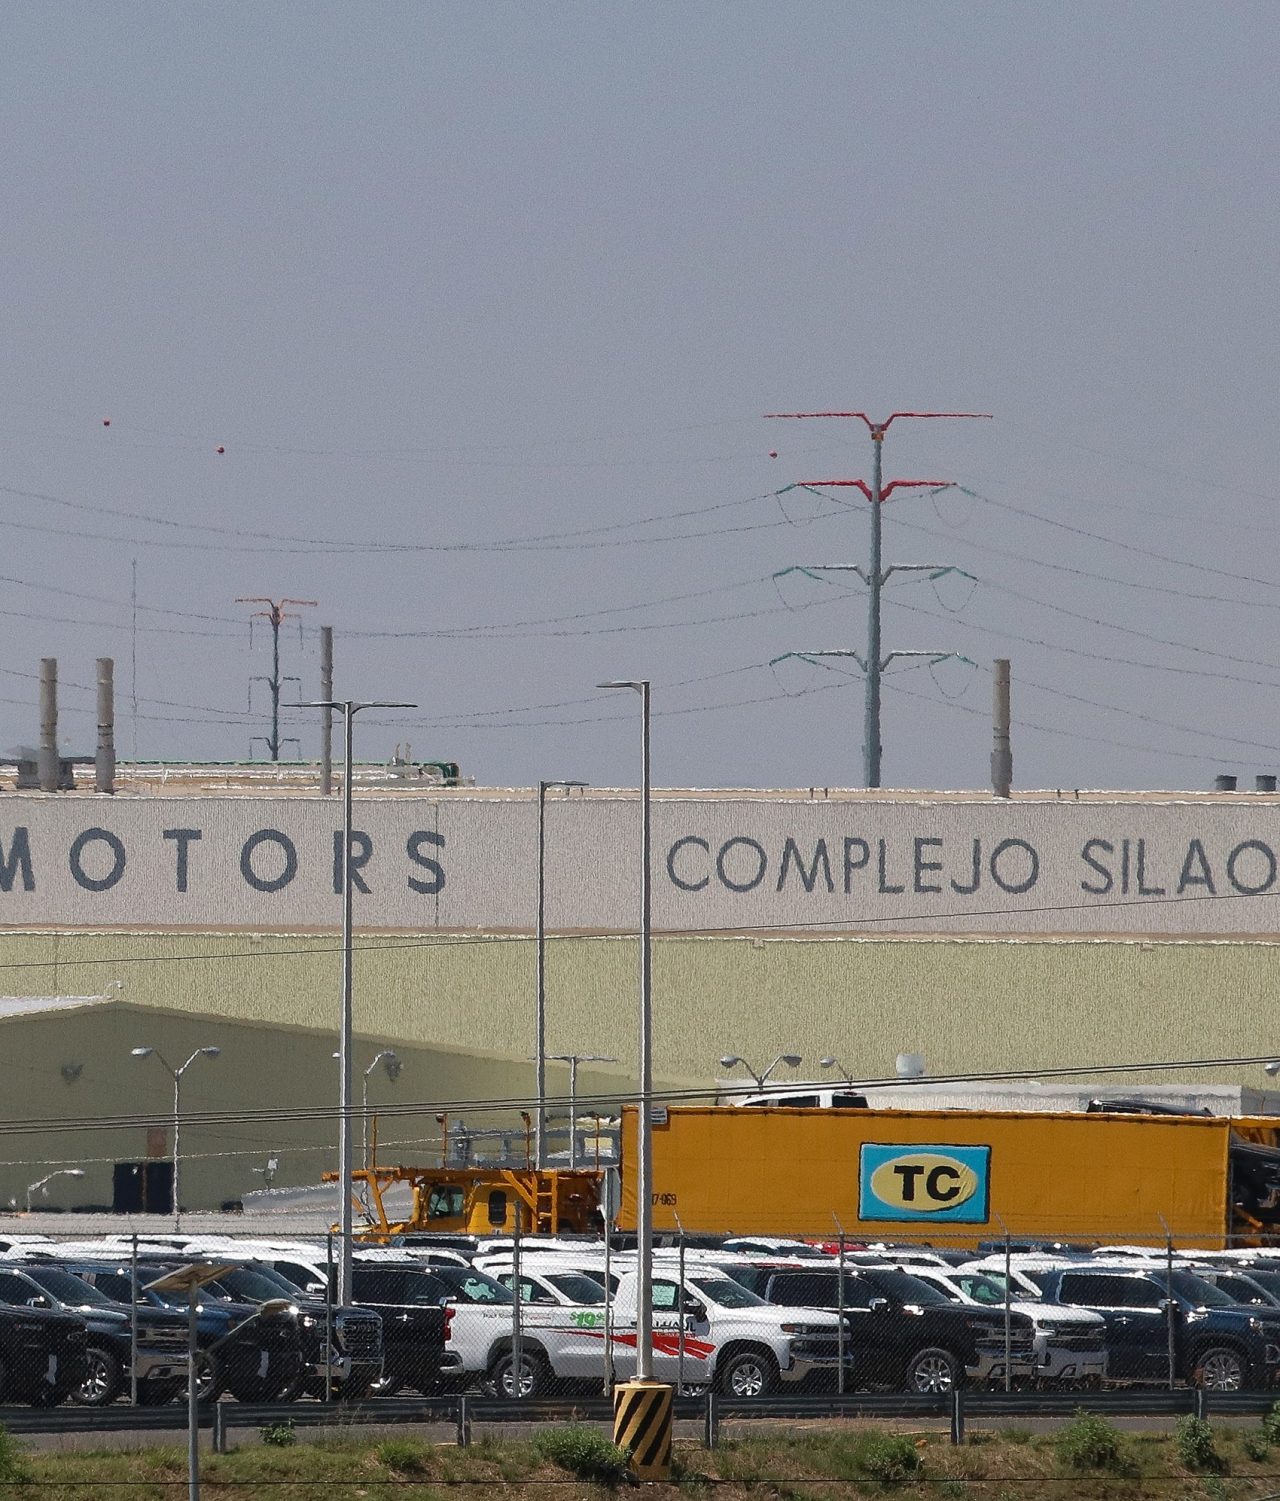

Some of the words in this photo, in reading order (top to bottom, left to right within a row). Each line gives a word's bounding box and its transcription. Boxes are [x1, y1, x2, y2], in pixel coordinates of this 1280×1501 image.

[666, 835, 1040, 895] COMPLEJO
[1080, 837, 1278, 897] SILAO
[893, 1165, 961, 1202] TC
